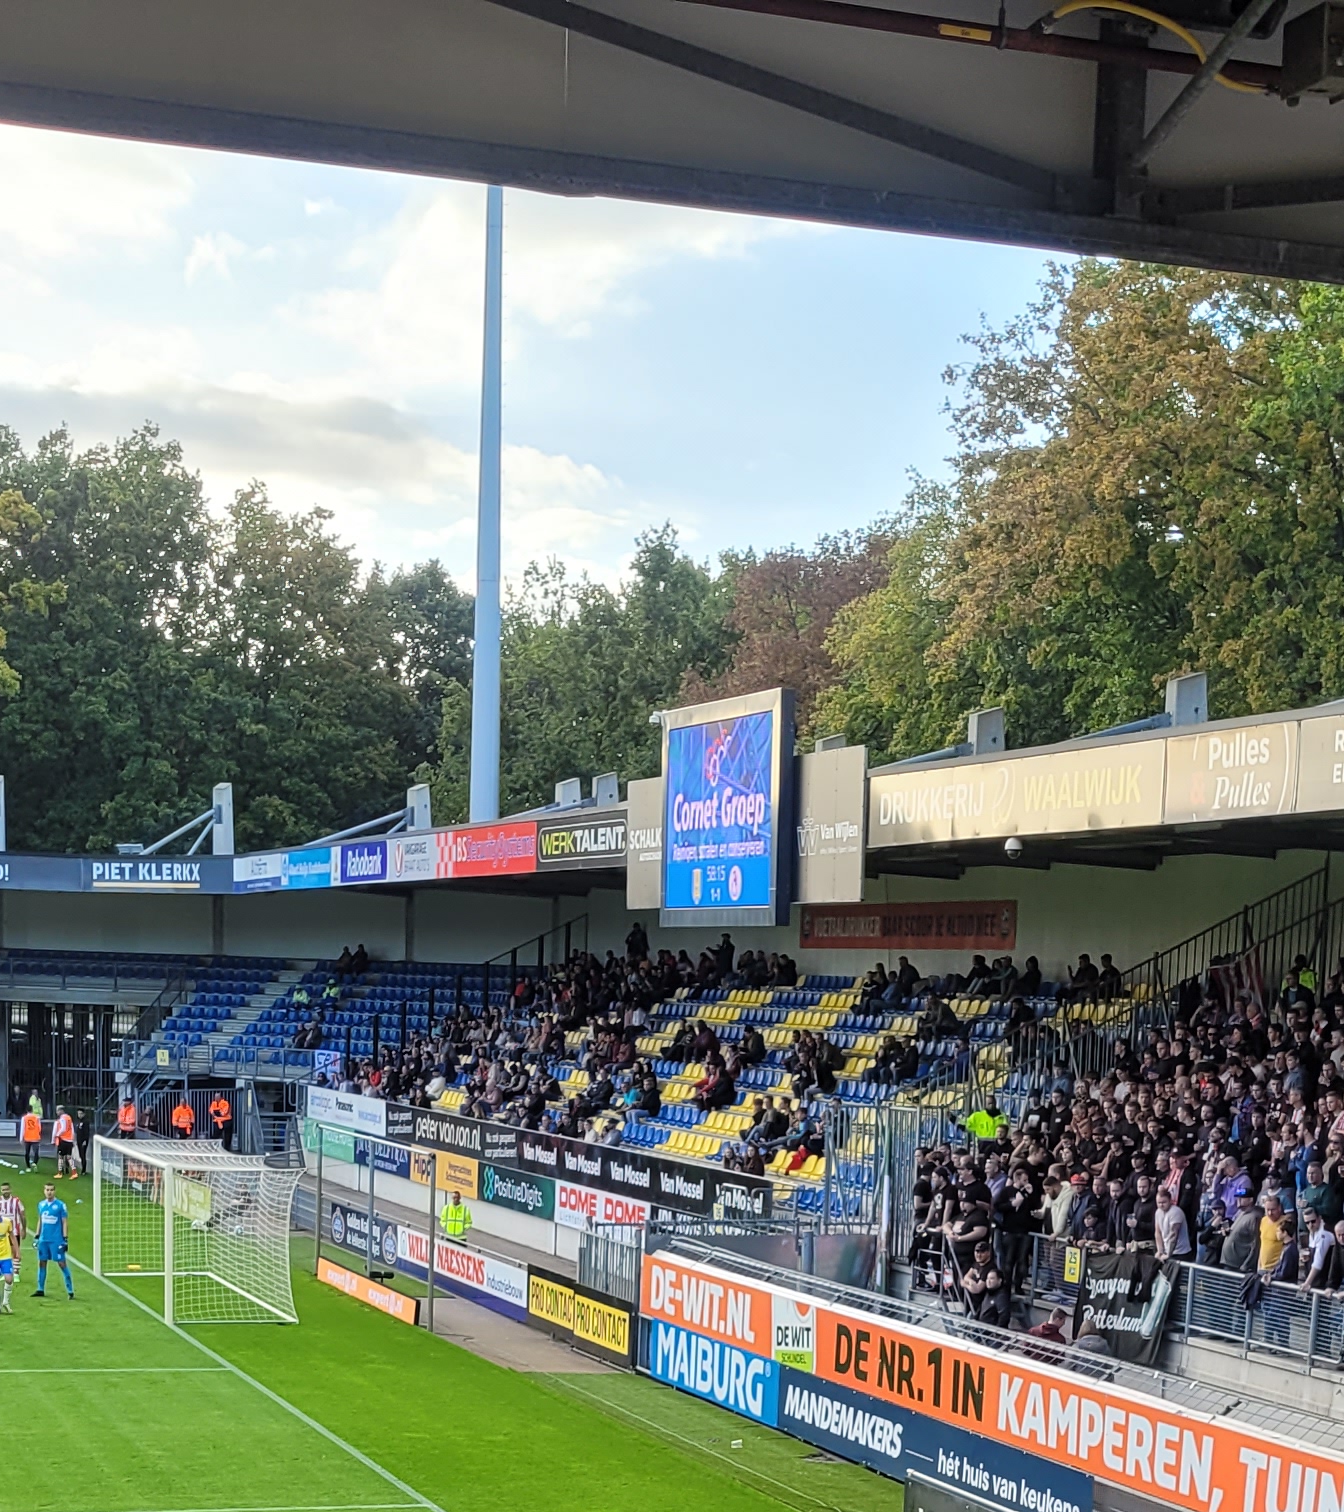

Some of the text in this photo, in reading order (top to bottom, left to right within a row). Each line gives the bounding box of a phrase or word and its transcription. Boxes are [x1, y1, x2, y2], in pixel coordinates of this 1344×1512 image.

[1208, 731, 1270, 771] Pulles
[879, 764, 1143, 826] DRUKKERIJ WAALWIJK
[1211, 771, 1272, 811] Pulles
[721, 786, 765, 836] Groep
[92, 861, 201, 882] PIET KLERKX
[346, 846, 383, 878] Rabobank
[415, 1113, 440, 1142] peter
[439, 1119, 456, 1145] van
[523, 1142, 557, 1166] Van Mossel
[564, 1151, 602, 1176] Van Mossel
[493, 1174, 543, 1212] PositiveDigits
[610, 1161, 650, 1189] Van Mossel
[660, 1171, 704, 1201] Van Mossel
[559, 1185, 597, 1217] DOME
[604, 1197, 646, 1227] DOME
[436, 1242, 486, 1286] NAESSENS
[486, 1272, 524, 1301] Industriebouw
[530, 1280, 545, 1310] PRO
[650, 1264, 756, 1344] DE-WIT.NL
[576, 1302, 628, 1350] PRO CONTACT
[776, 1325, 812, 1349] DE WIT
[656, 1322, 766, 1418] MAIBURG
[834, 1322, 870, 1383] DE
[952, 1358, 986, 1423] IN
[784, 1384, 904, 1460] MANDEMAKERS
[937, 1447, 961, 1481] hét
[962, 1461, 990, 1494] huis
[992, 1474, 1018, 1504] van
